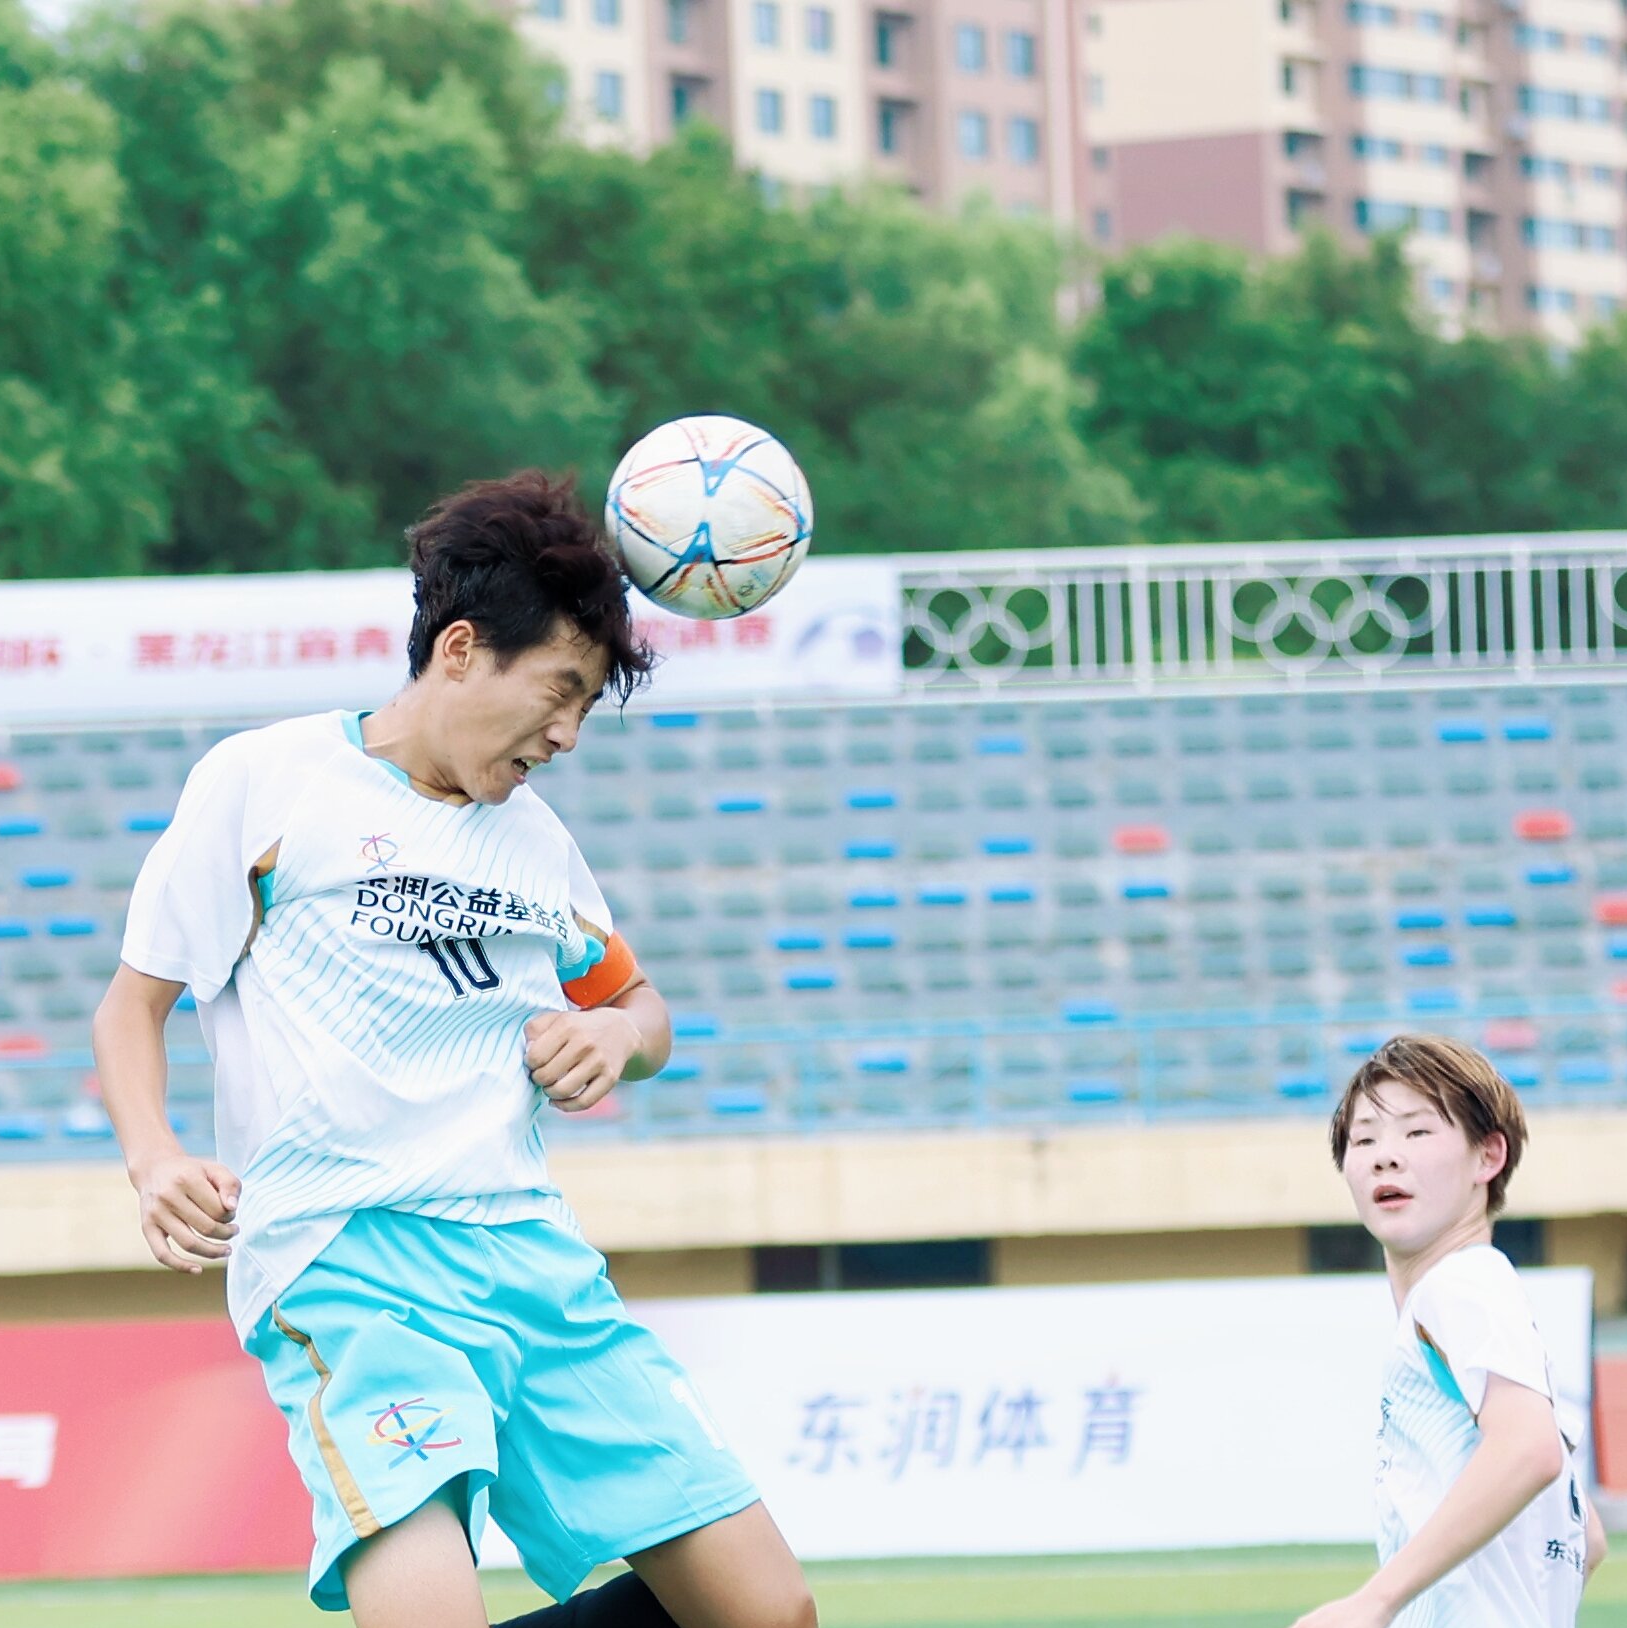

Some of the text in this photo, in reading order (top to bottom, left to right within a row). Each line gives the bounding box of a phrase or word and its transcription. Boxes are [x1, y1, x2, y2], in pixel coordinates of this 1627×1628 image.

[356, 889, 513, 938] DONGRU
[416, 936, 503, 1000] 10
[784, 1374, 1146, 1482] 东润体育
